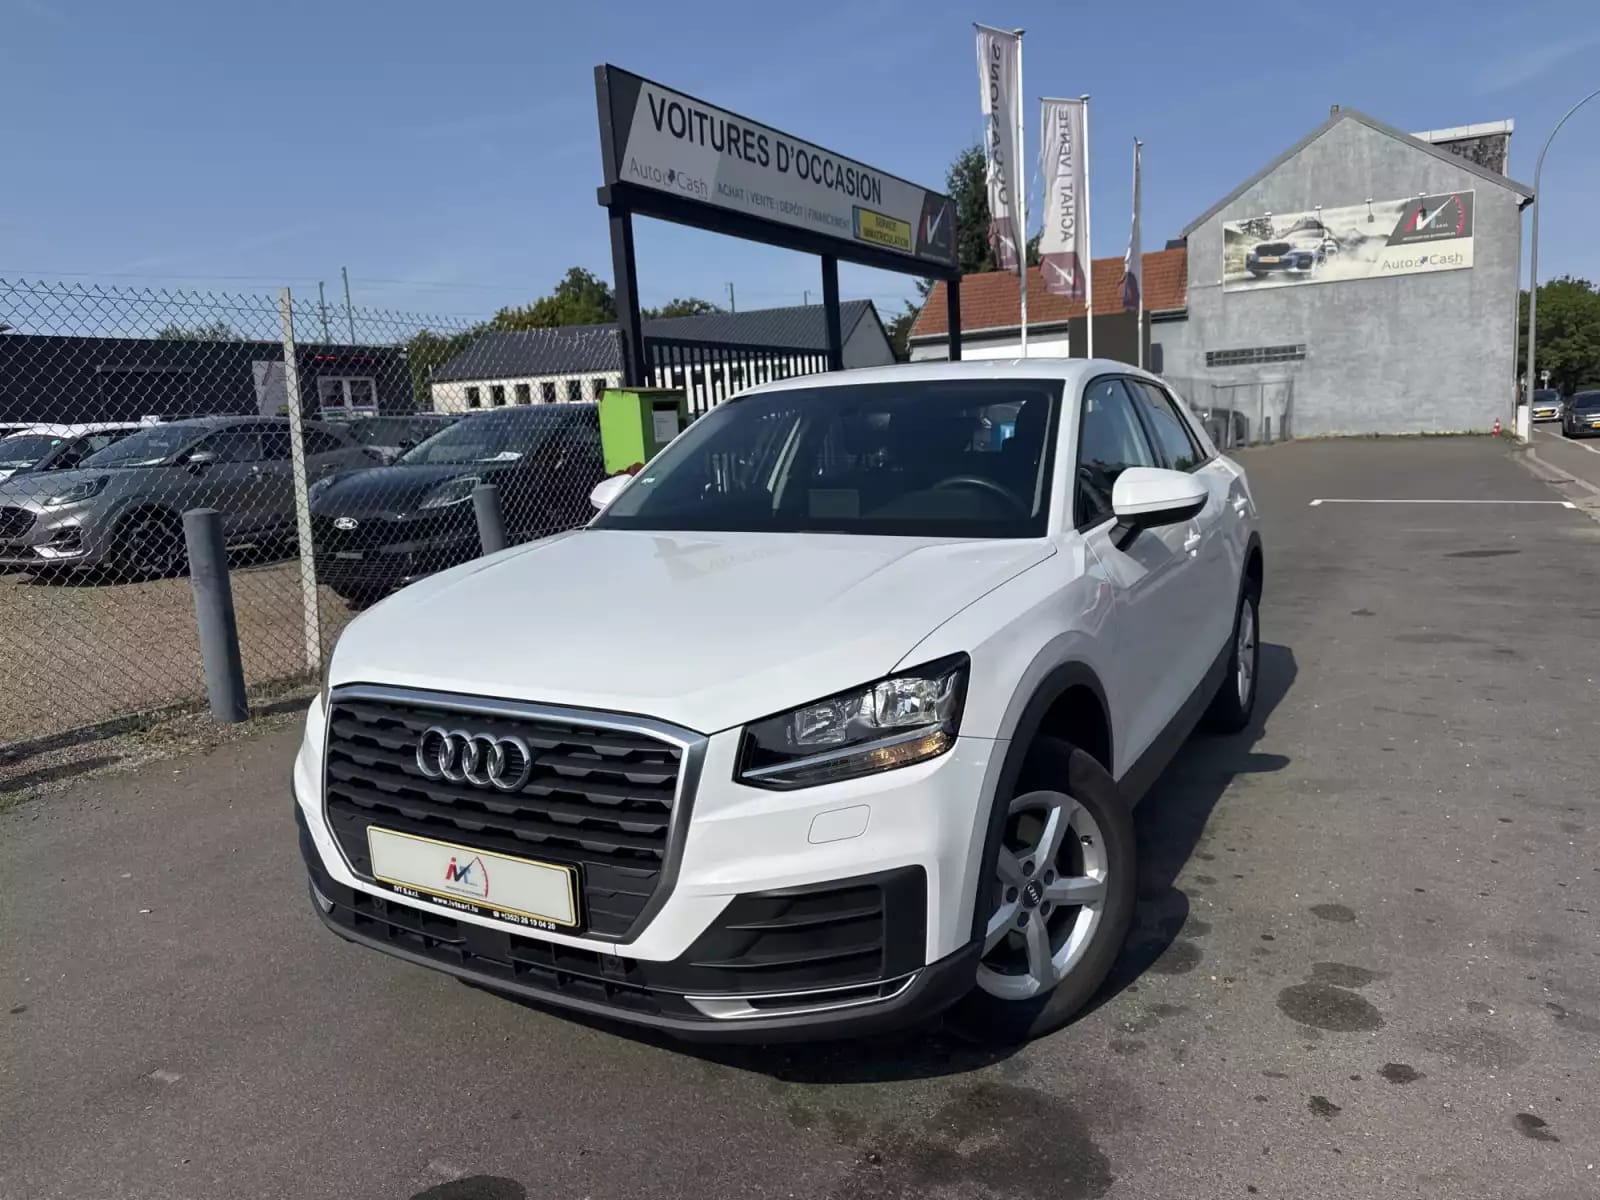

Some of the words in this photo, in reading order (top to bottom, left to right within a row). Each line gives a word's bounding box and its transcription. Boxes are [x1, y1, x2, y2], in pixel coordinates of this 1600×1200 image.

[647, 92, 770, 168] VOITURES
[776, 140, 881, 206] D'OCCASION
[718, 182, 745, 201] ACHAT
[750, 190, 777, 210] VENTE
